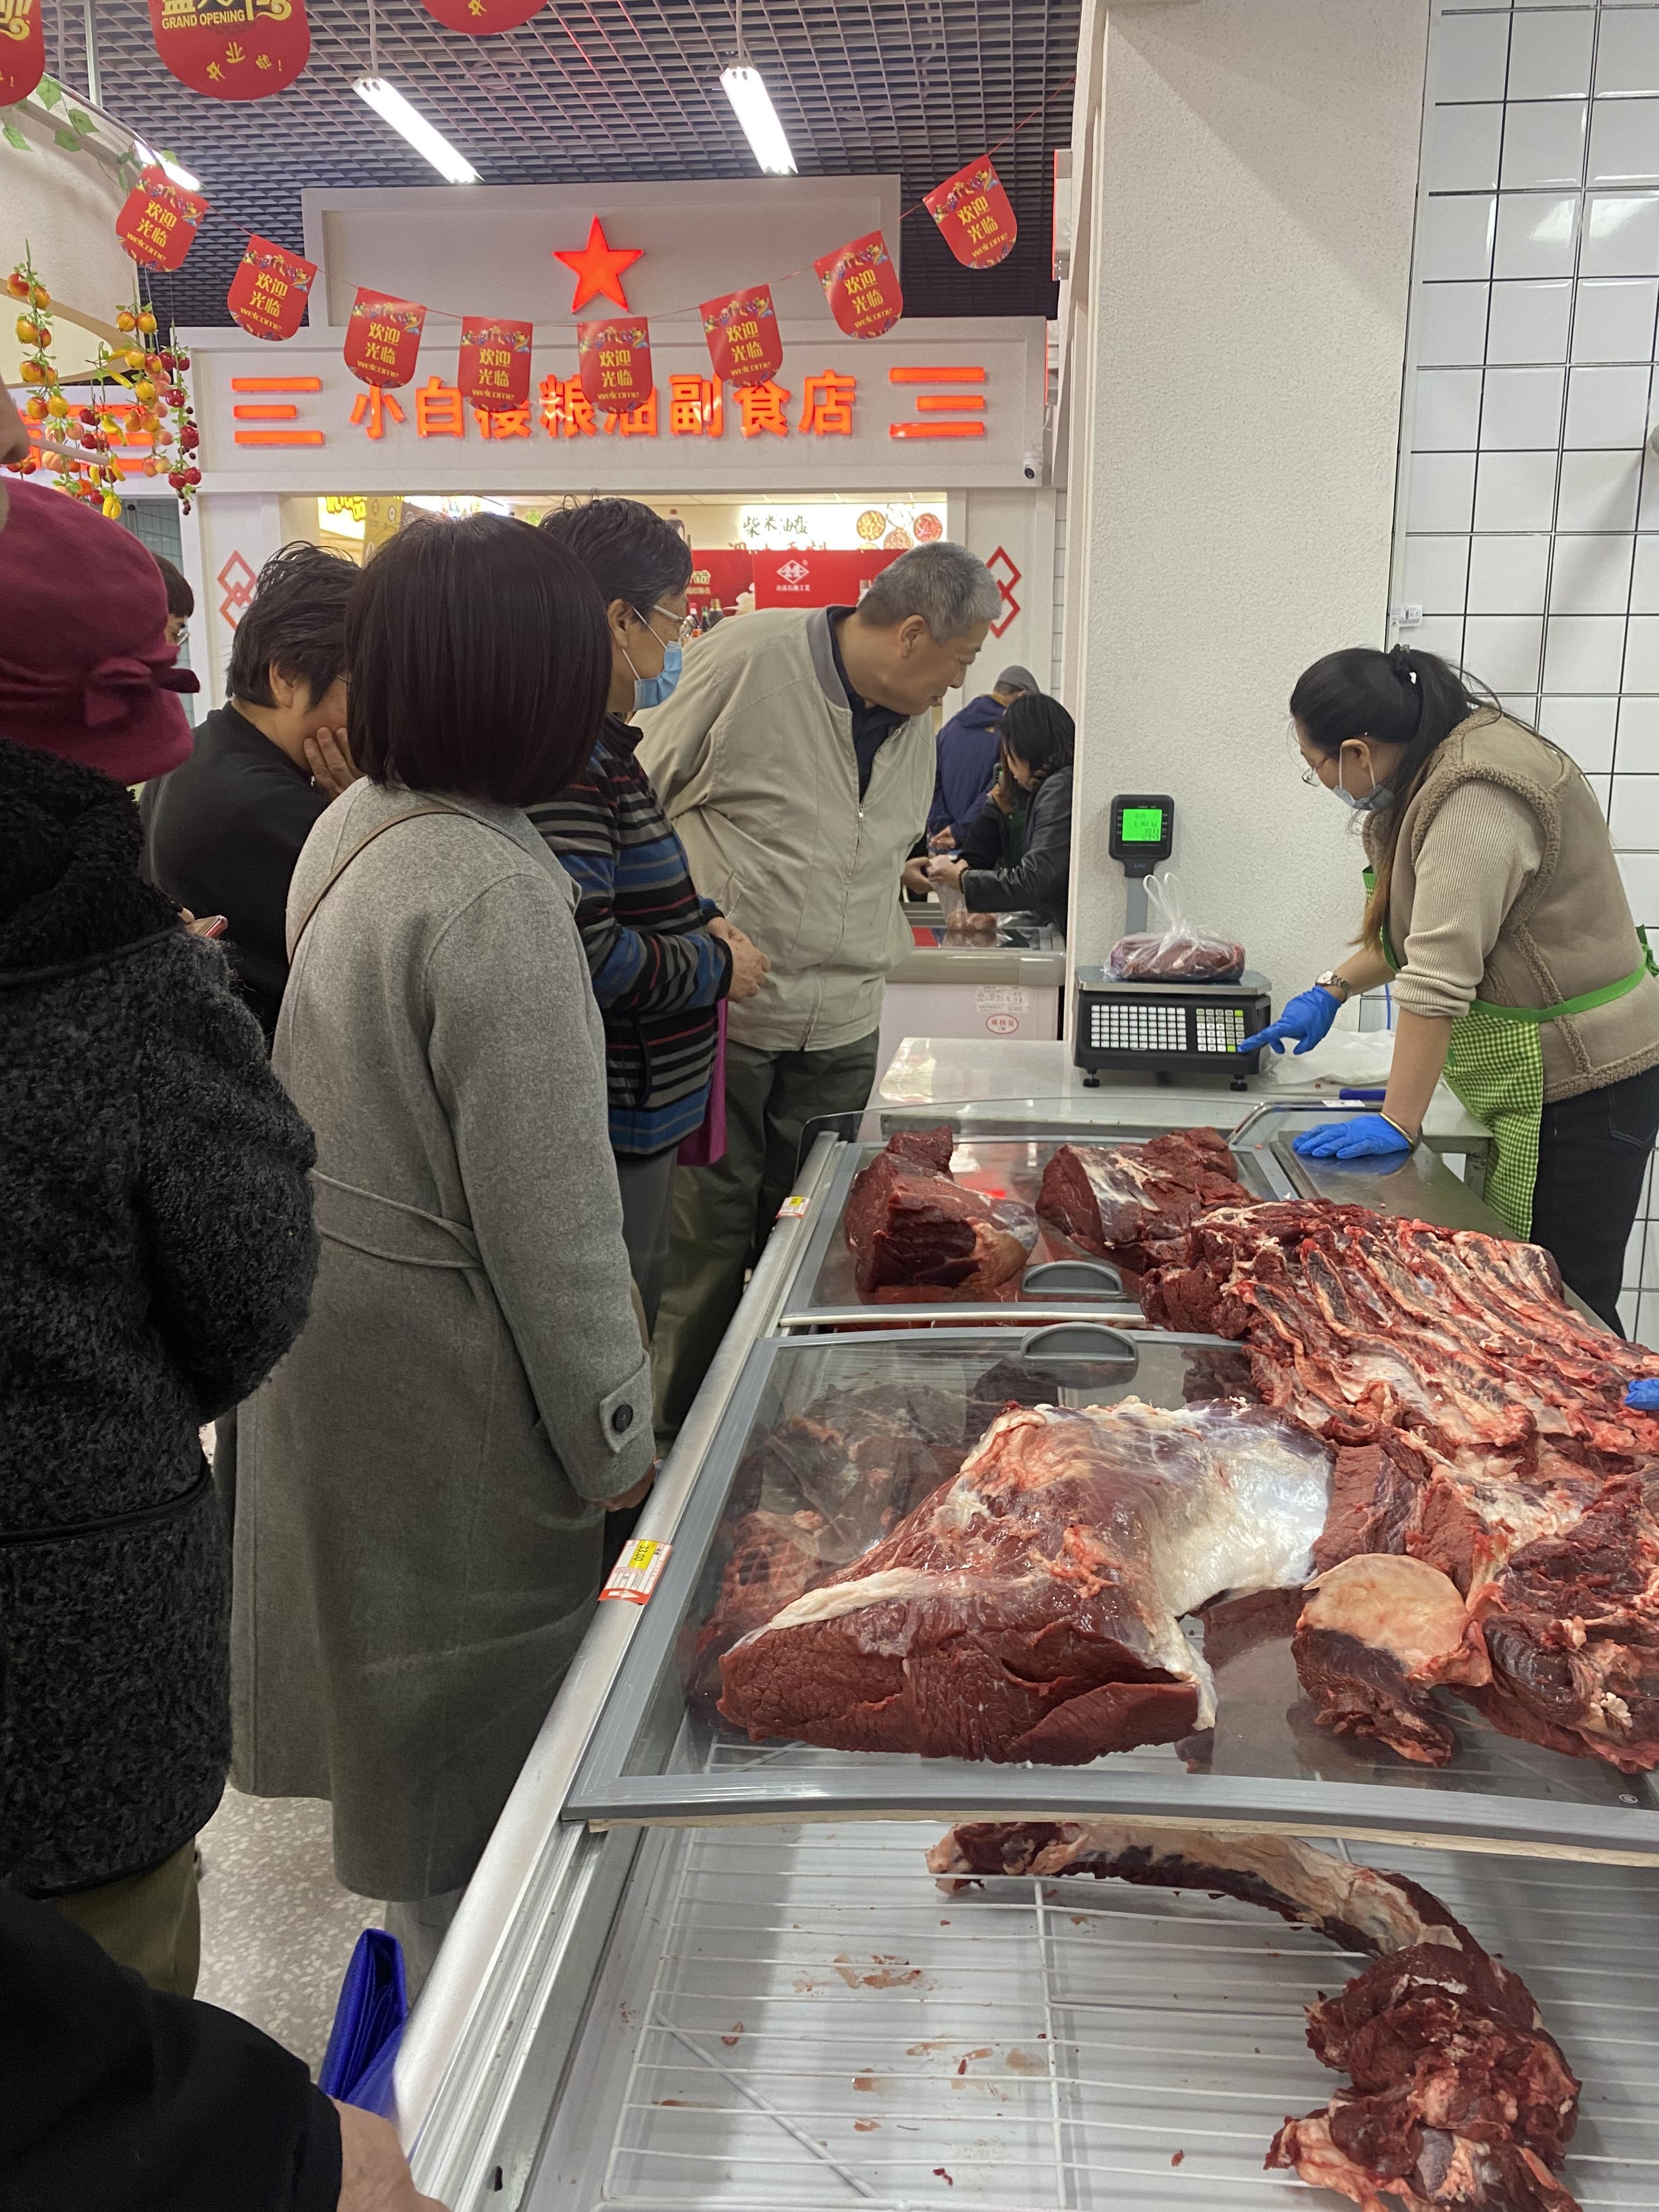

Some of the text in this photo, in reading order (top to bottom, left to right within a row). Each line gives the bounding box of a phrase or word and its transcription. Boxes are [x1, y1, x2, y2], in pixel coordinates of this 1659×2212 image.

[162, 15, 198, 30] GRAND
[199, 9, 245, 26] OPENING
[145, 200, 177, 231] 欢迎
[956, 196, 990, 225] 欢迎
[137, 217, 169, 247] 光临
[967, 215, 998, 244] 光临
[127, 232, 166, 261] welcome
[972, 233, 1008, 257] welcome
[255, 271, 288, 300] 欢迎
[843, 269, 877, 295] 欢迎
[249, 290, 281, 317] 光临
[852, 289, 883, 314] 光临
[240, 307, 281, 330] welcome
[854, 307, 892, 328] welcome
[369, 321, 400, 346] 欢迎
[726, 321, 759, 343] 欢迎
[365, 342, 396, 365] 光临
[479, 348, 511, 368] 欢迎
[599, 349, 631, 367] 欢迎
[731, 341, 763, 363] 光临
[357, 360, 399, 377] welcome
[478, 369, 509, 387] 光临
[601, 369, 633, 387] 光临
[730, 361, 771, 376] welcome
[472, 388, 515, 400] welcome
[597, 391, 640, 400] welcome
[743, 514, 808, 538] 柴米油盐
[634, 1545, 650, 1561] 33.00
